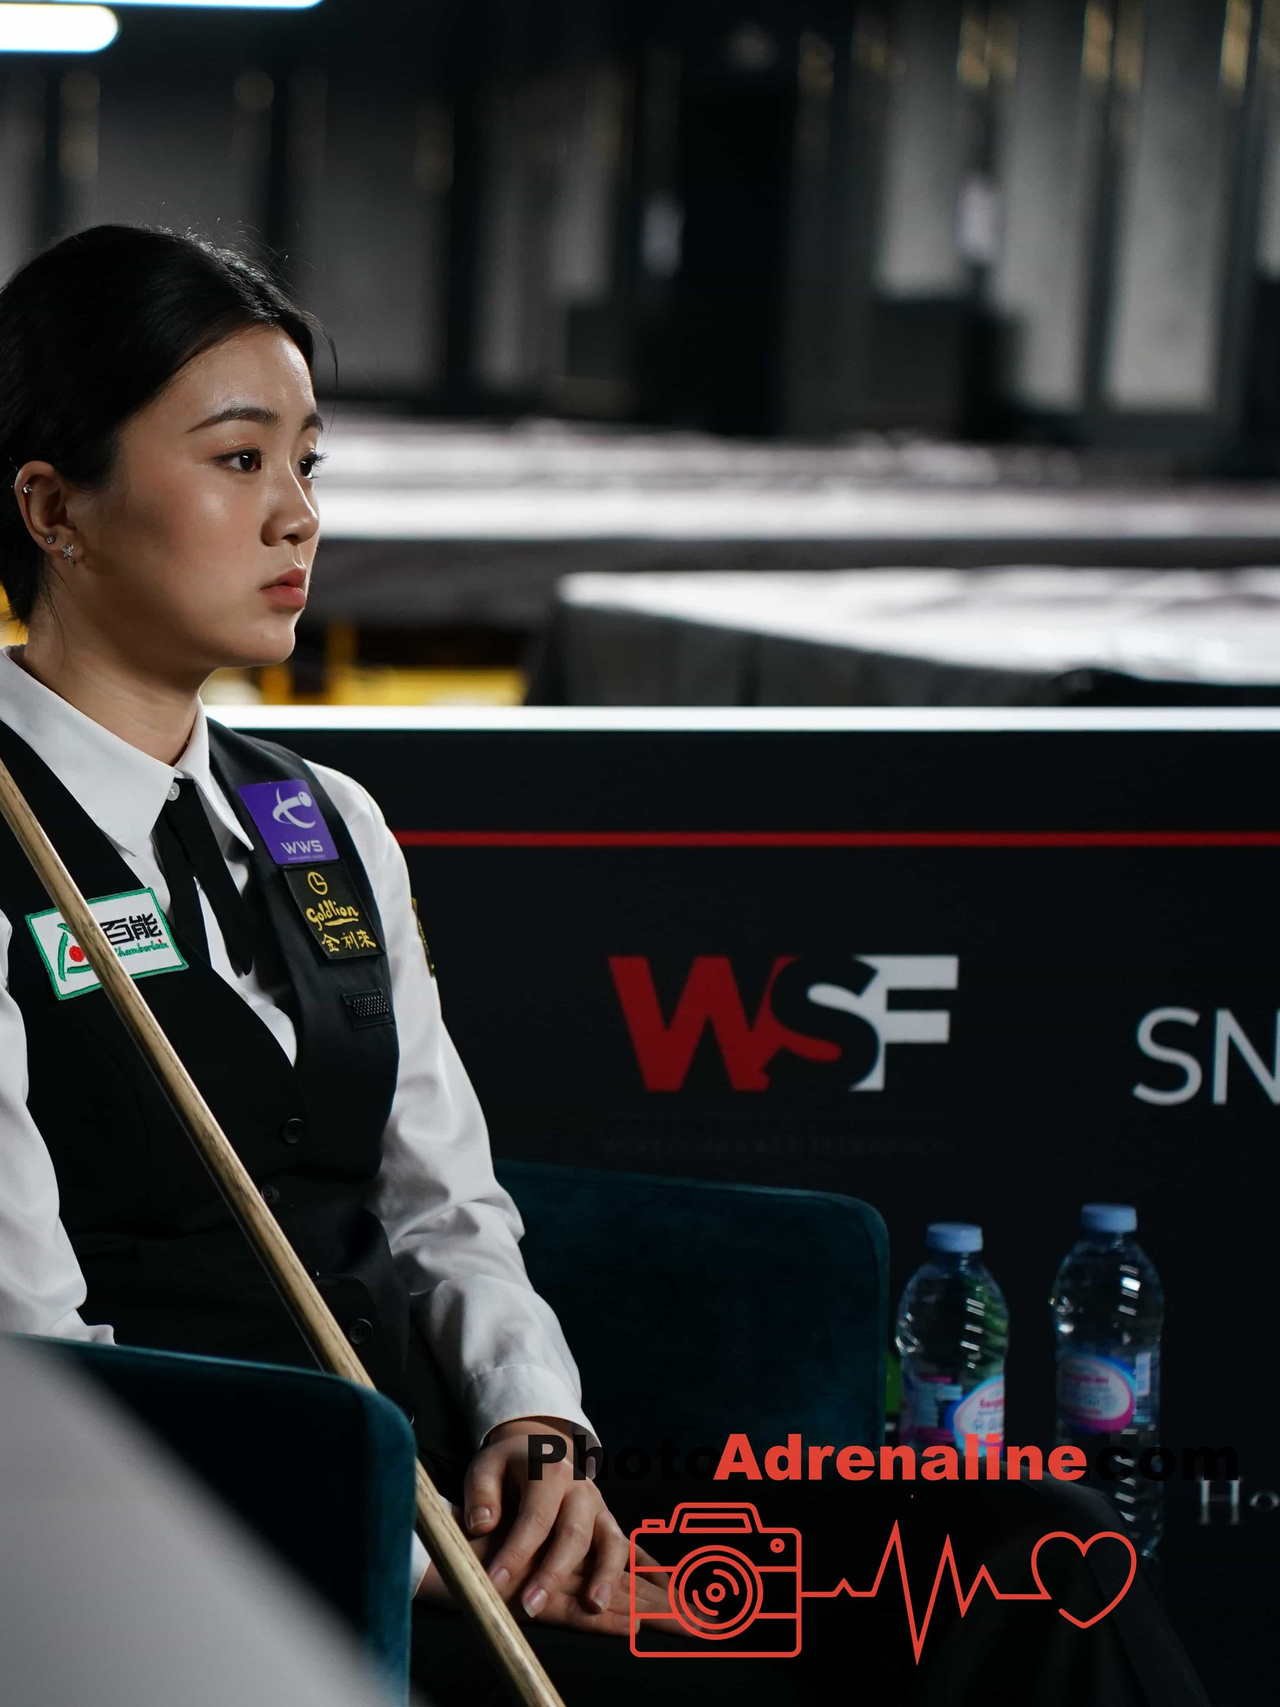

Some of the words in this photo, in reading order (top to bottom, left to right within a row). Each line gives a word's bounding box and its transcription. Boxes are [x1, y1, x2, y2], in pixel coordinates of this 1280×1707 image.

[280, 839, 324, 855] WWS
[321, 929, 376, 952] 金利来
[608, 954, 960, 1091] WSF
